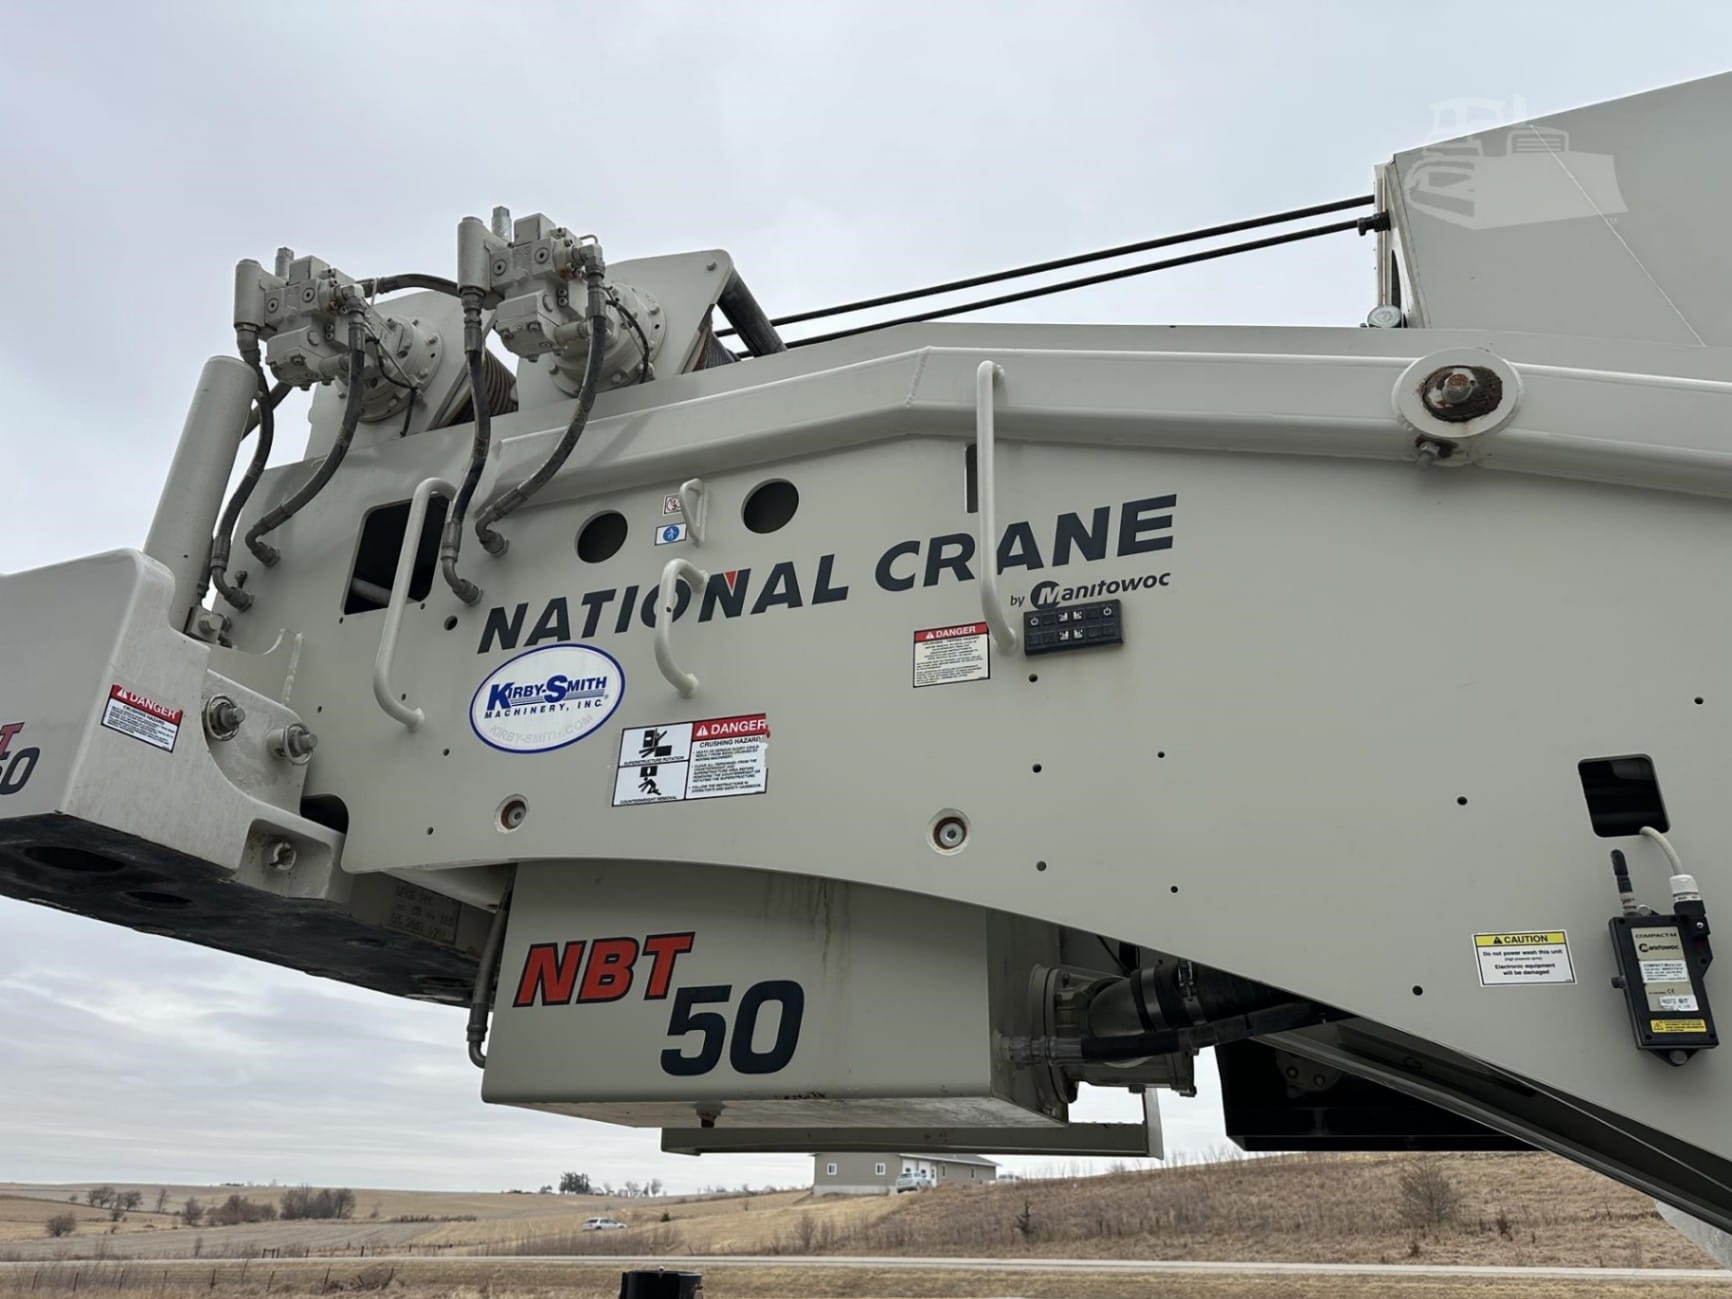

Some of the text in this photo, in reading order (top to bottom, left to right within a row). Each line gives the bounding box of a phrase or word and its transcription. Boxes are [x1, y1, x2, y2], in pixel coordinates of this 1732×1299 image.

[477, 493, 1177, 653] NATIONAL CRANE
[1010, 572, 1171, 610] by Manitowoc
[936, 626, 976, 637] DANGER
[130, 692, 175, 719] DANGER
[487, 675, 607, 710] KIRBY-SMITH
[484, 704, 569, 719] MACHINERY,
[711, 719, 766, 734] DANGER
[700, 740, 733, 748] CRUSHING
[0, 747, 40, 794] 0
[1504, 935, 1548, 944] CAUTION
[513, 932, 695, 1007] NBT
[660, 980, 804, 1076] 50
